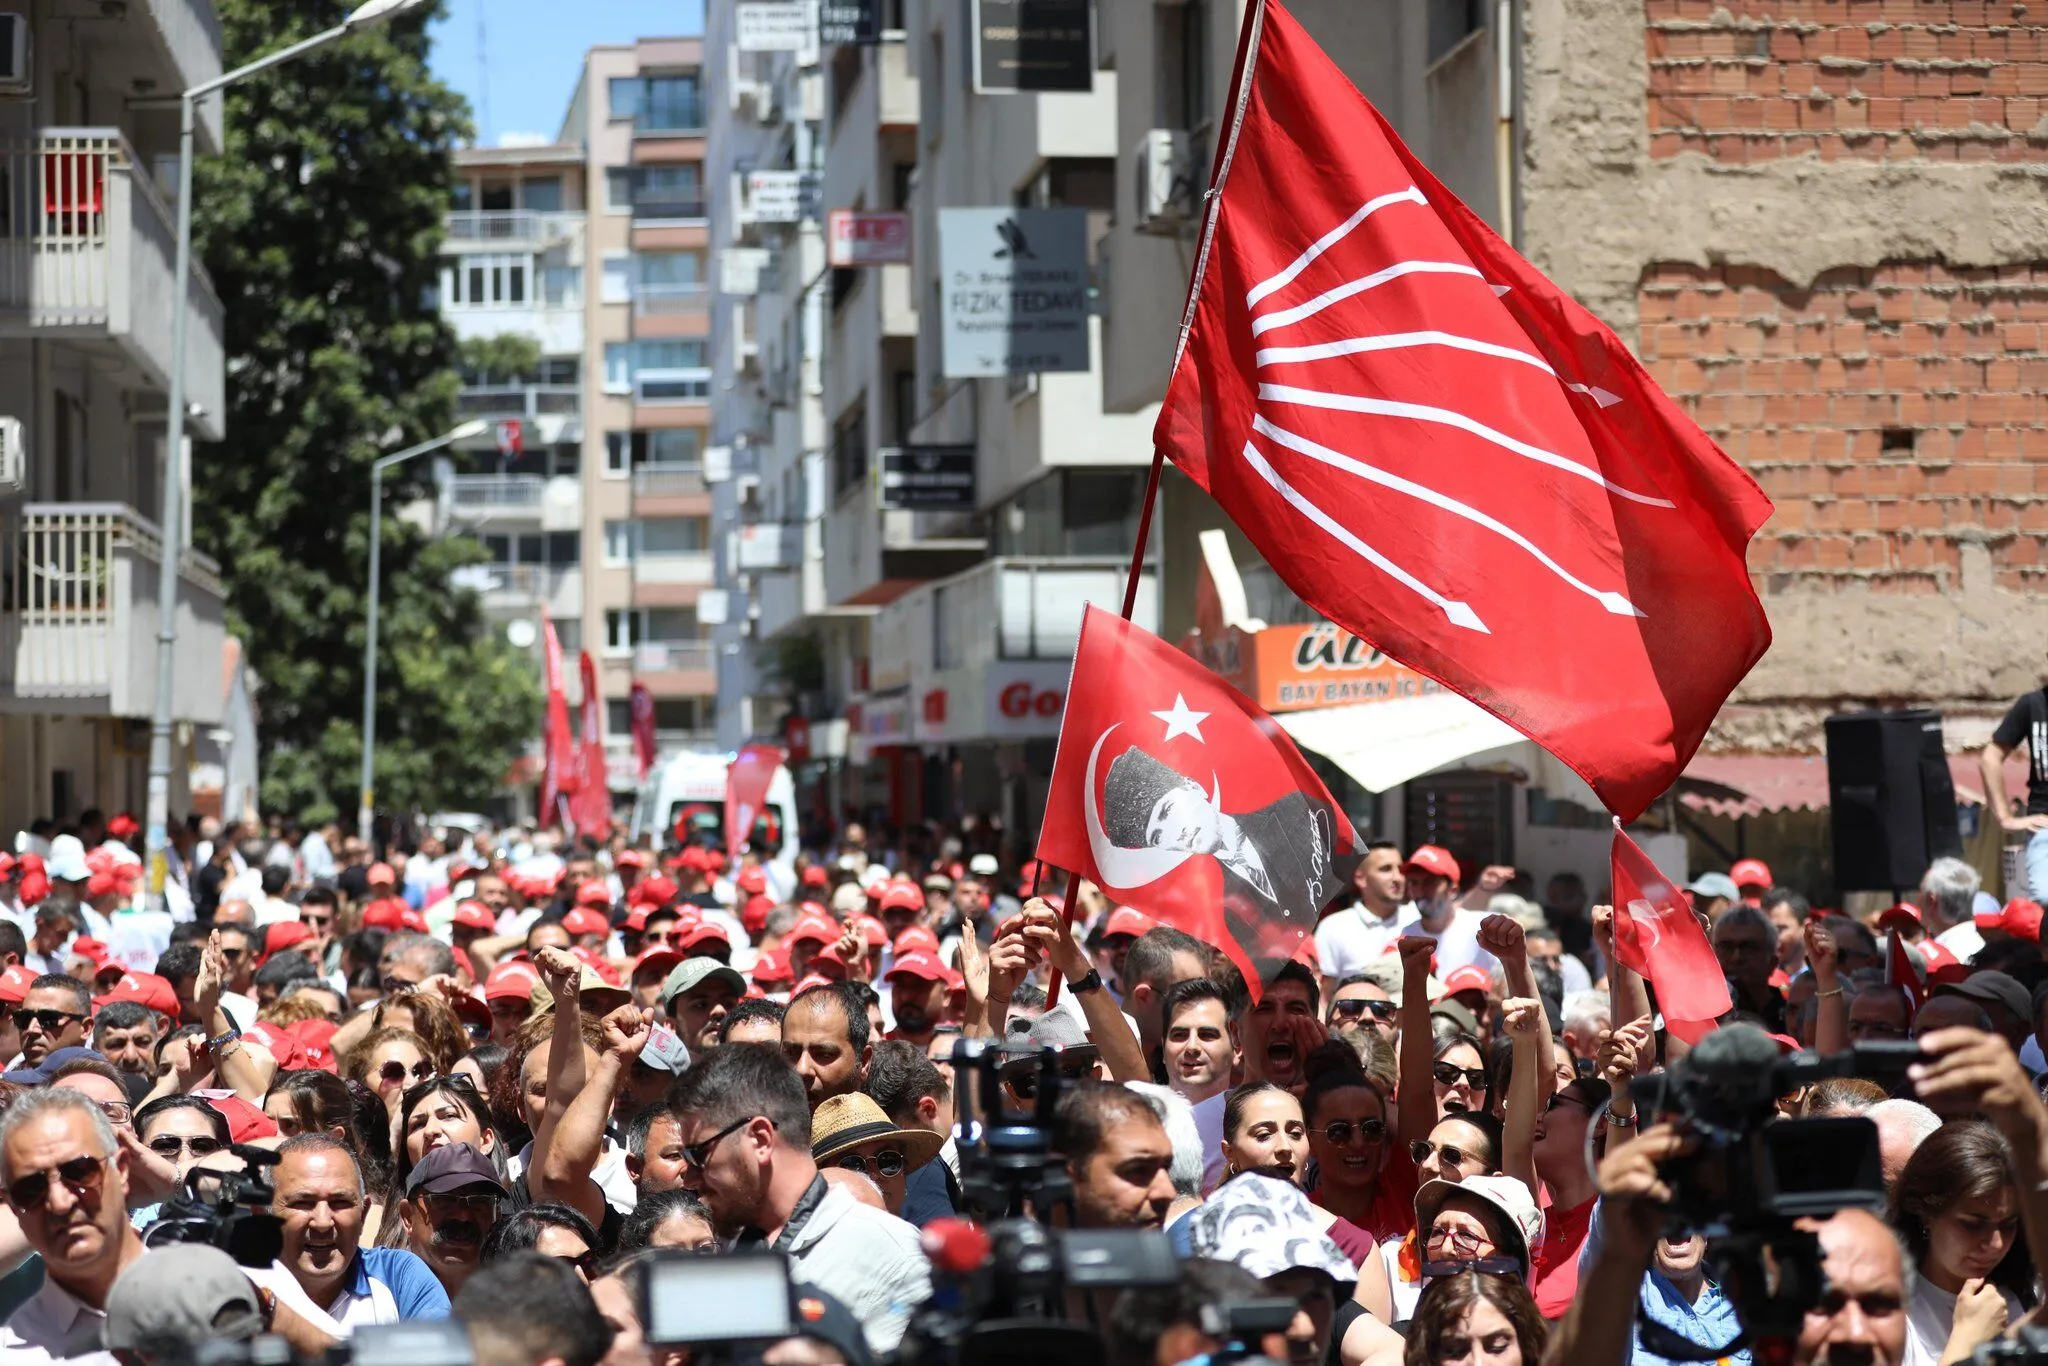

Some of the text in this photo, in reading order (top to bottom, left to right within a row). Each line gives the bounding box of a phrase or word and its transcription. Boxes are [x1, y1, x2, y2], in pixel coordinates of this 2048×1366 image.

[999, 680, 1063, 718] Go
[1280, 684, 1318, 702] BAY
[1325, 679, 1390, 700] BAYAN
